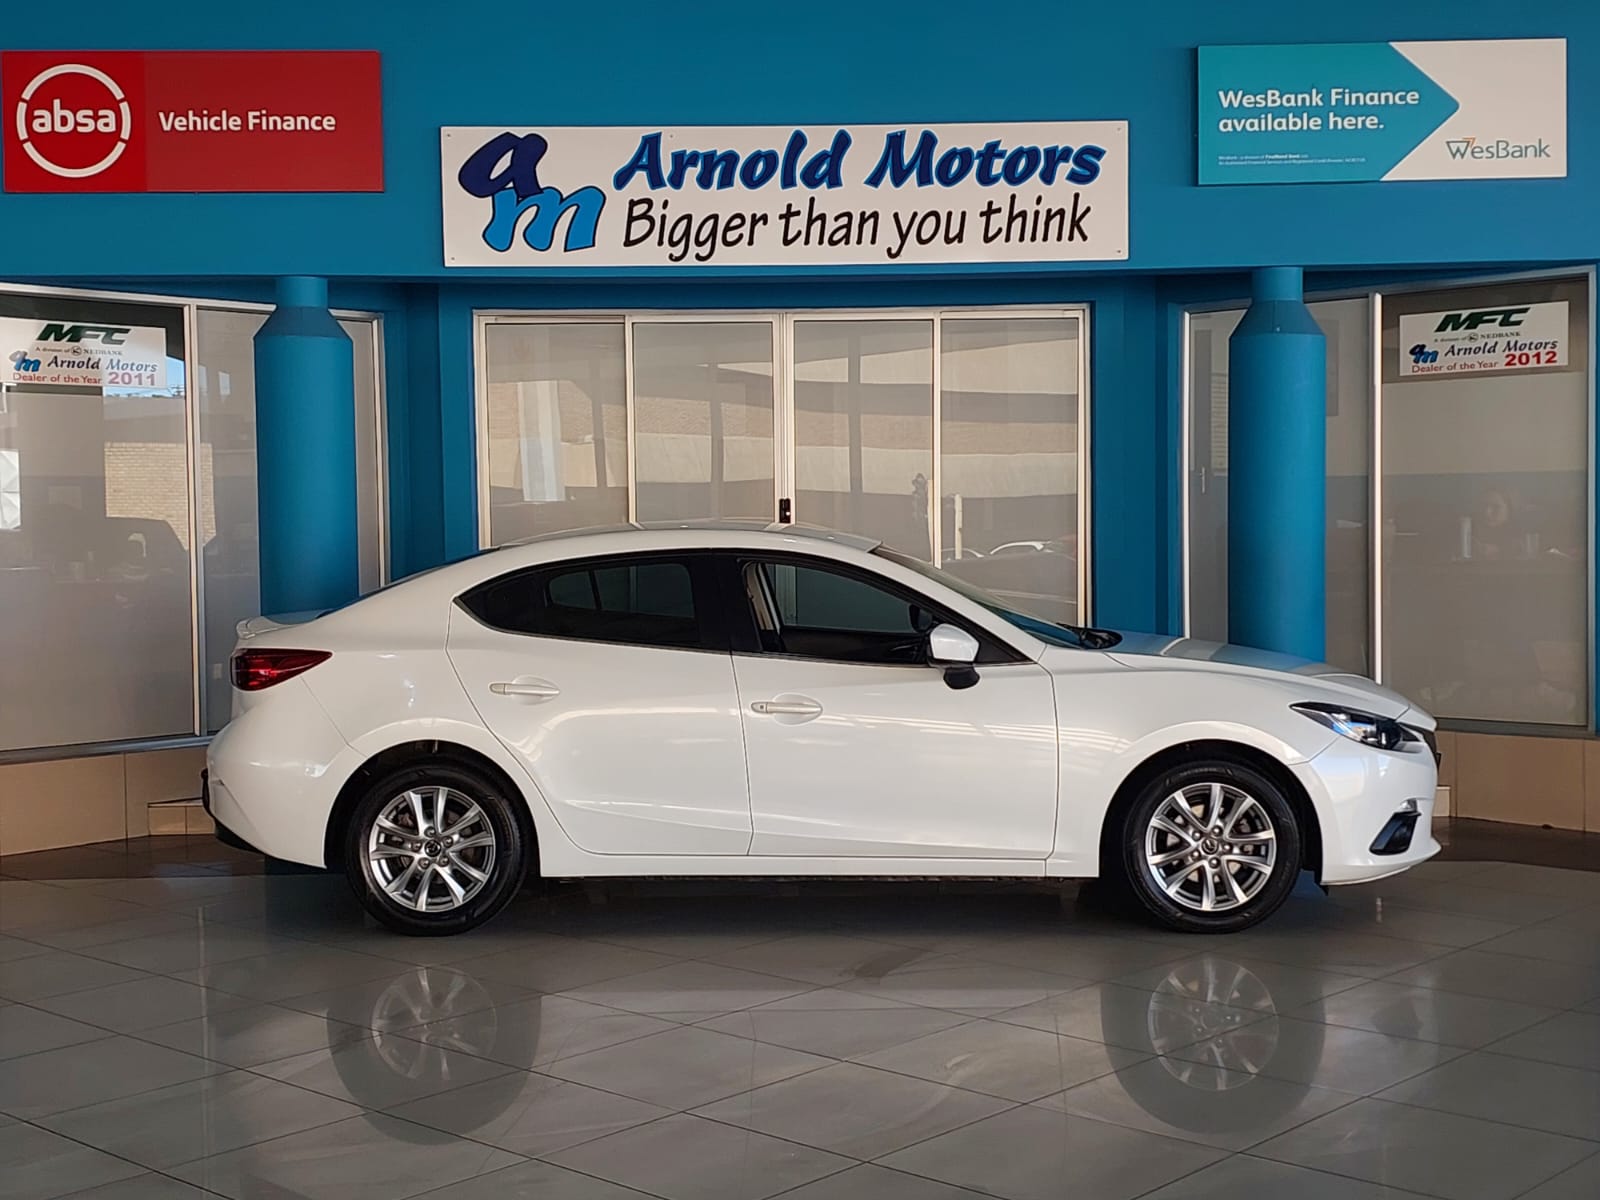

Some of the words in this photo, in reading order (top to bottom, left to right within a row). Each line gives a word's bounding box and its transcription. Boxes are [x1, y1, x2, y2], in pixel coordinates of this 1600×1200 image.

[1218, 88, 1324, 108] WesBank
[1330, 87, 1420, 106] Finance
[32, 98, 116, 133] absa
[158, 110, 242, 132] Vehicle
[247, 110, 336, 132] Finance
[1218, 112, 1322, 133] available
[1328, 111, 1385, 130] here.
[1446, 136, 1551, 160] WesBank
[613, 130, 854, 191] Arnold
[863, 130, 1108, 188] Motors
[622, 198, 769, 262] Bigger
[781, 197, 880, 247] than
[885, 207, 973, 259] you
[978, 192, 1092, 245] think
[1434, 306, 1531, 333] MFC
[36, 322, 131, 345] MFC
[1480, 331, 1521, 340] NEDBANK
[1444, 340, 1498, 357] Arnold
[1502, 339, 1558, 353] Motors
[47, 355, 102, 370] Arnold
[105, 358, 158, 373] Motors
[1411, 363, 1443, 373] Dealer
[1446, 362, 1458, 371] of
[1460, 361, 1475, 370] the
[1477, 359, 1498, 369] Year
[1504, 350, 1558, 367] 2012
[13, 372, 47, 383] Dealer
[50, 373, 61, 383] of
[63, 374, 80, 384] the
[81, 375, 102, 385] Year
[107, 372, 157, 386] 2011
